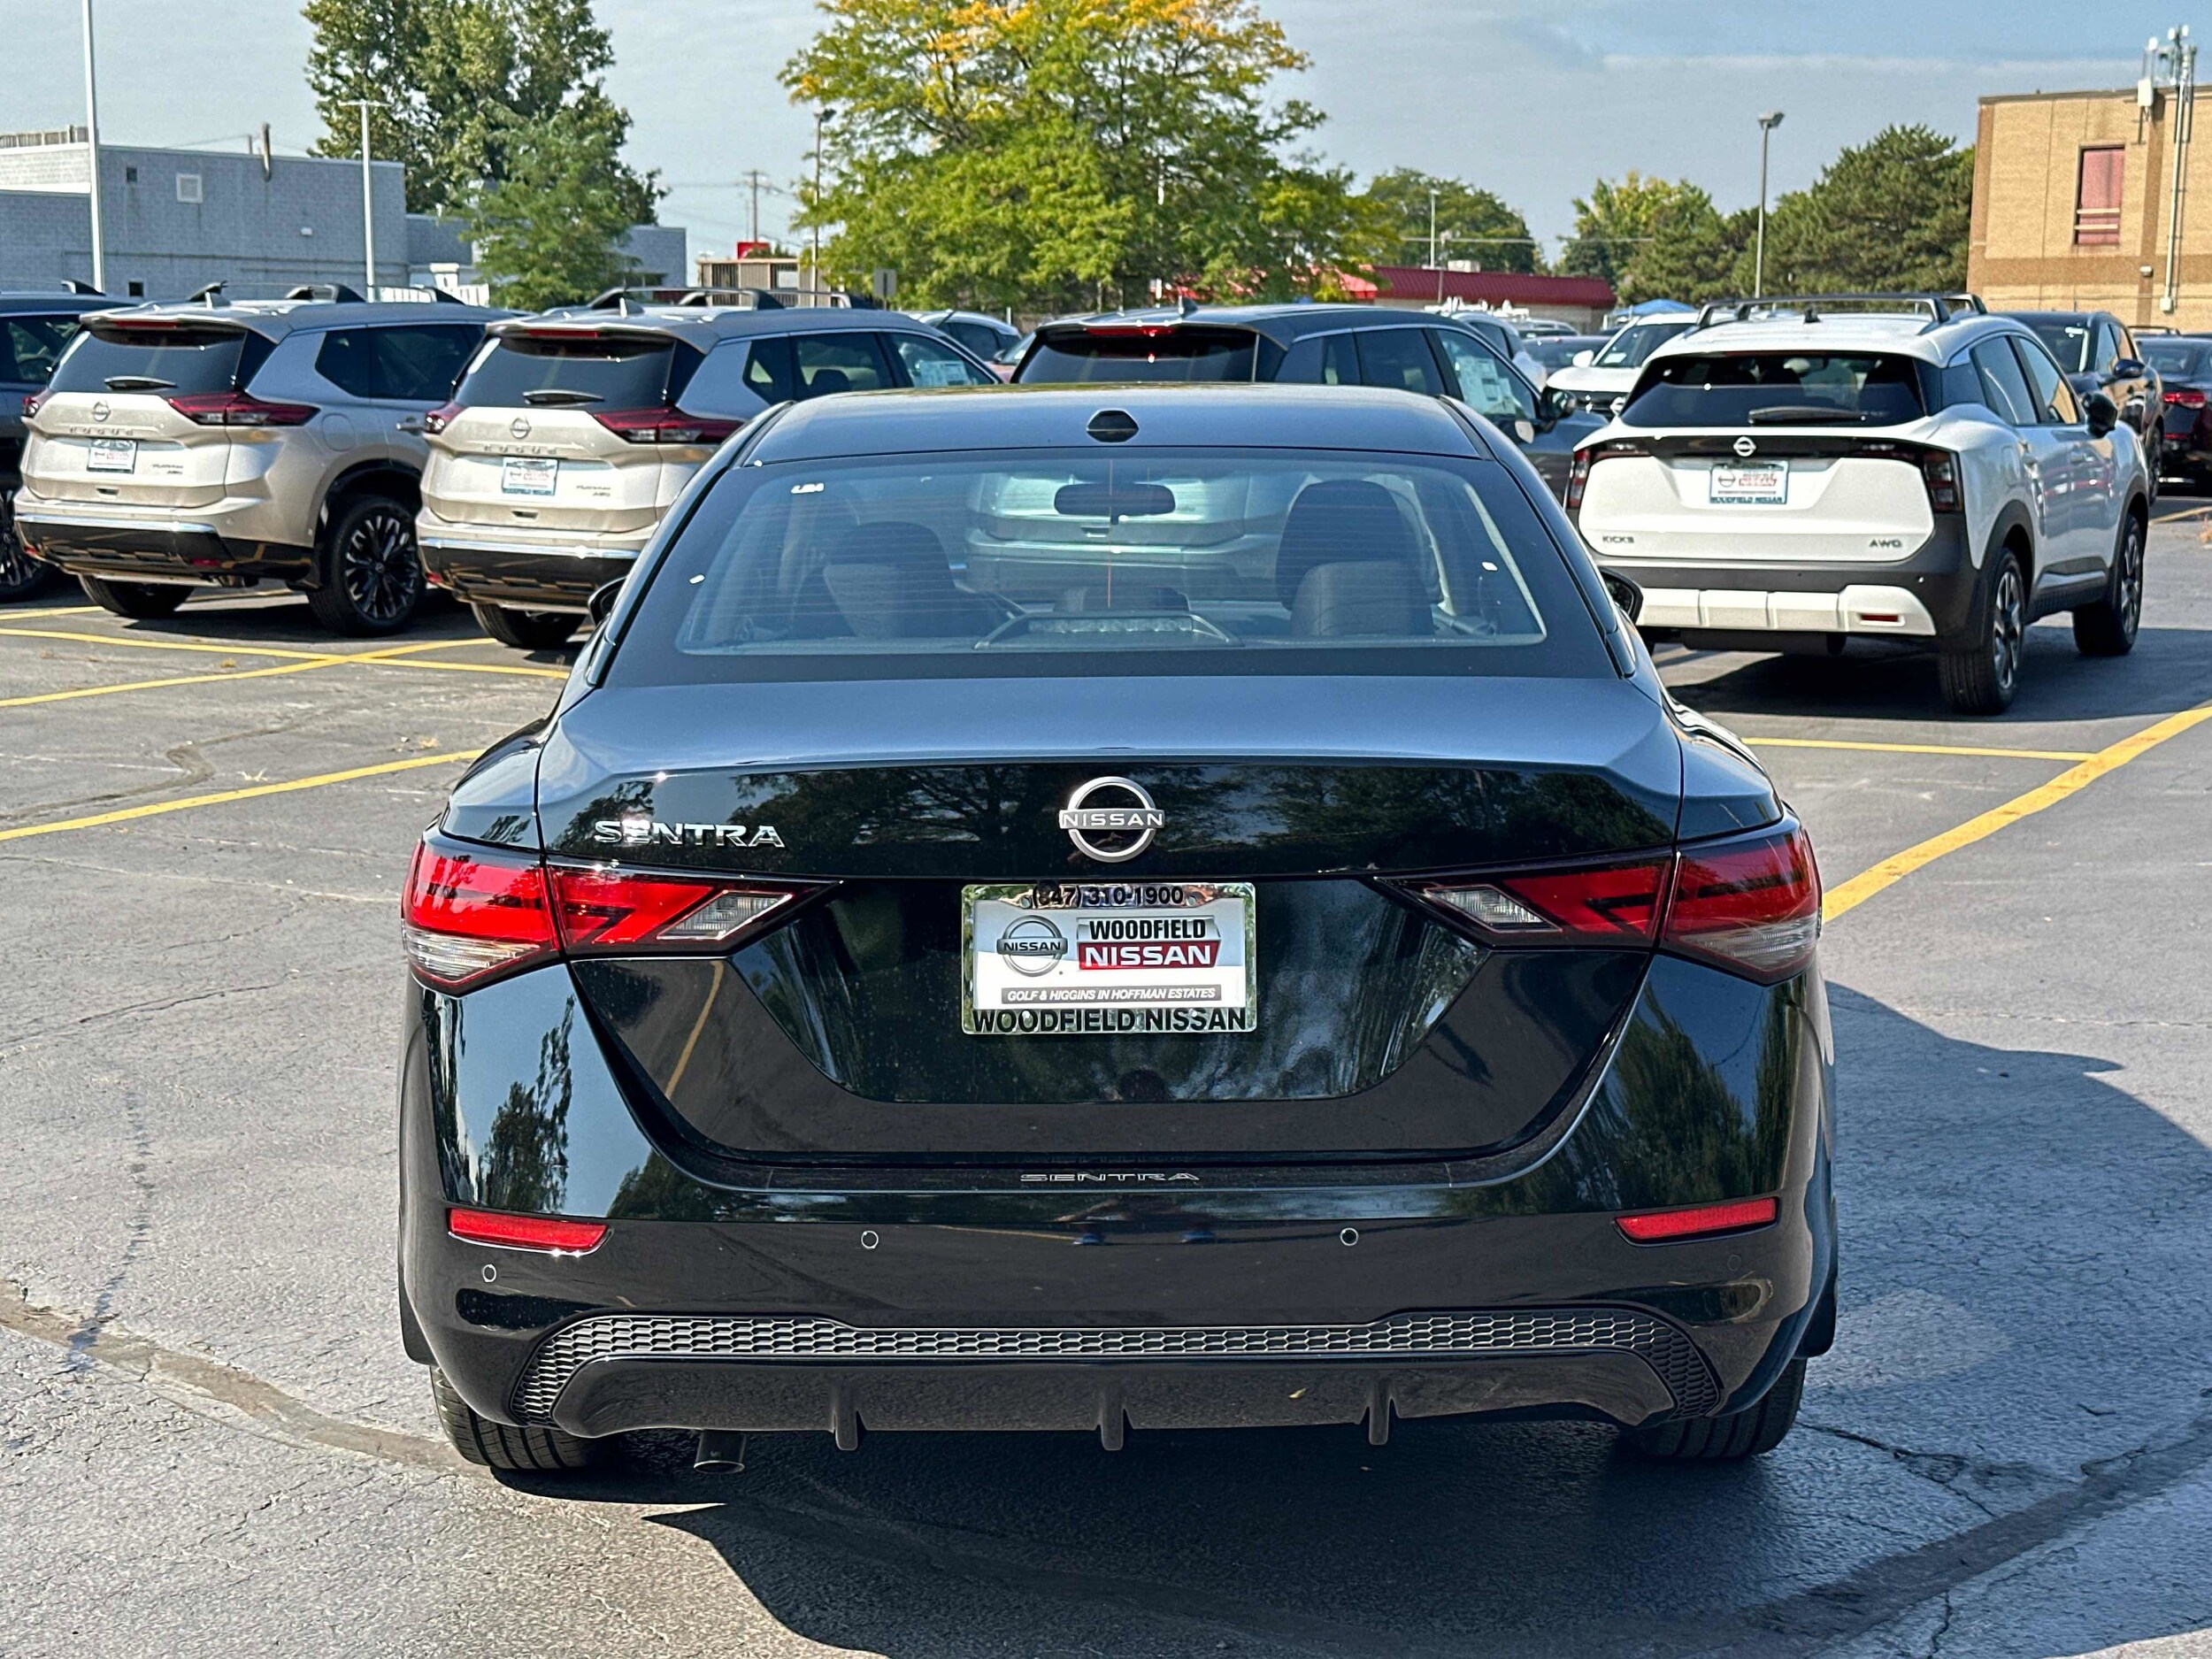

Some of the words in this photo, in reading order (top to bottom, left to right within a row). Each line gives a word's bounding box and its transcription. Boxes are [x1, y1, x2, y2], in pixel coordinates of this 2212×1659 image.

[1869, 539, 1903, 548] AWD
[1063, 813, 1164, 826] NISSAN
[594, 820, 786, 848] SENTRA
[1089, 918, 1207, 941] WOODFIELD
[1003, 941, 1062, 952] NISSAN
[1085, 945, 1212, 967] NISSAN
[1007, 990, 1040, 1001] GOLF
[1039, 990, 1048, 1001] &
[1048, 989, 1095, 1001] HIGGINS
[1097, 989, 1110, 1000] IN
[1110, 988, 1167, 1000] HOFFMAN
[1167, 987, 1217, 998] ESTATES
[972, 1008, 1136, 1033] WOODFIELD
[1144, 1007, 1248, 1031] NISSAN
[1019, 1171, 1202, 1183] SENTRA
